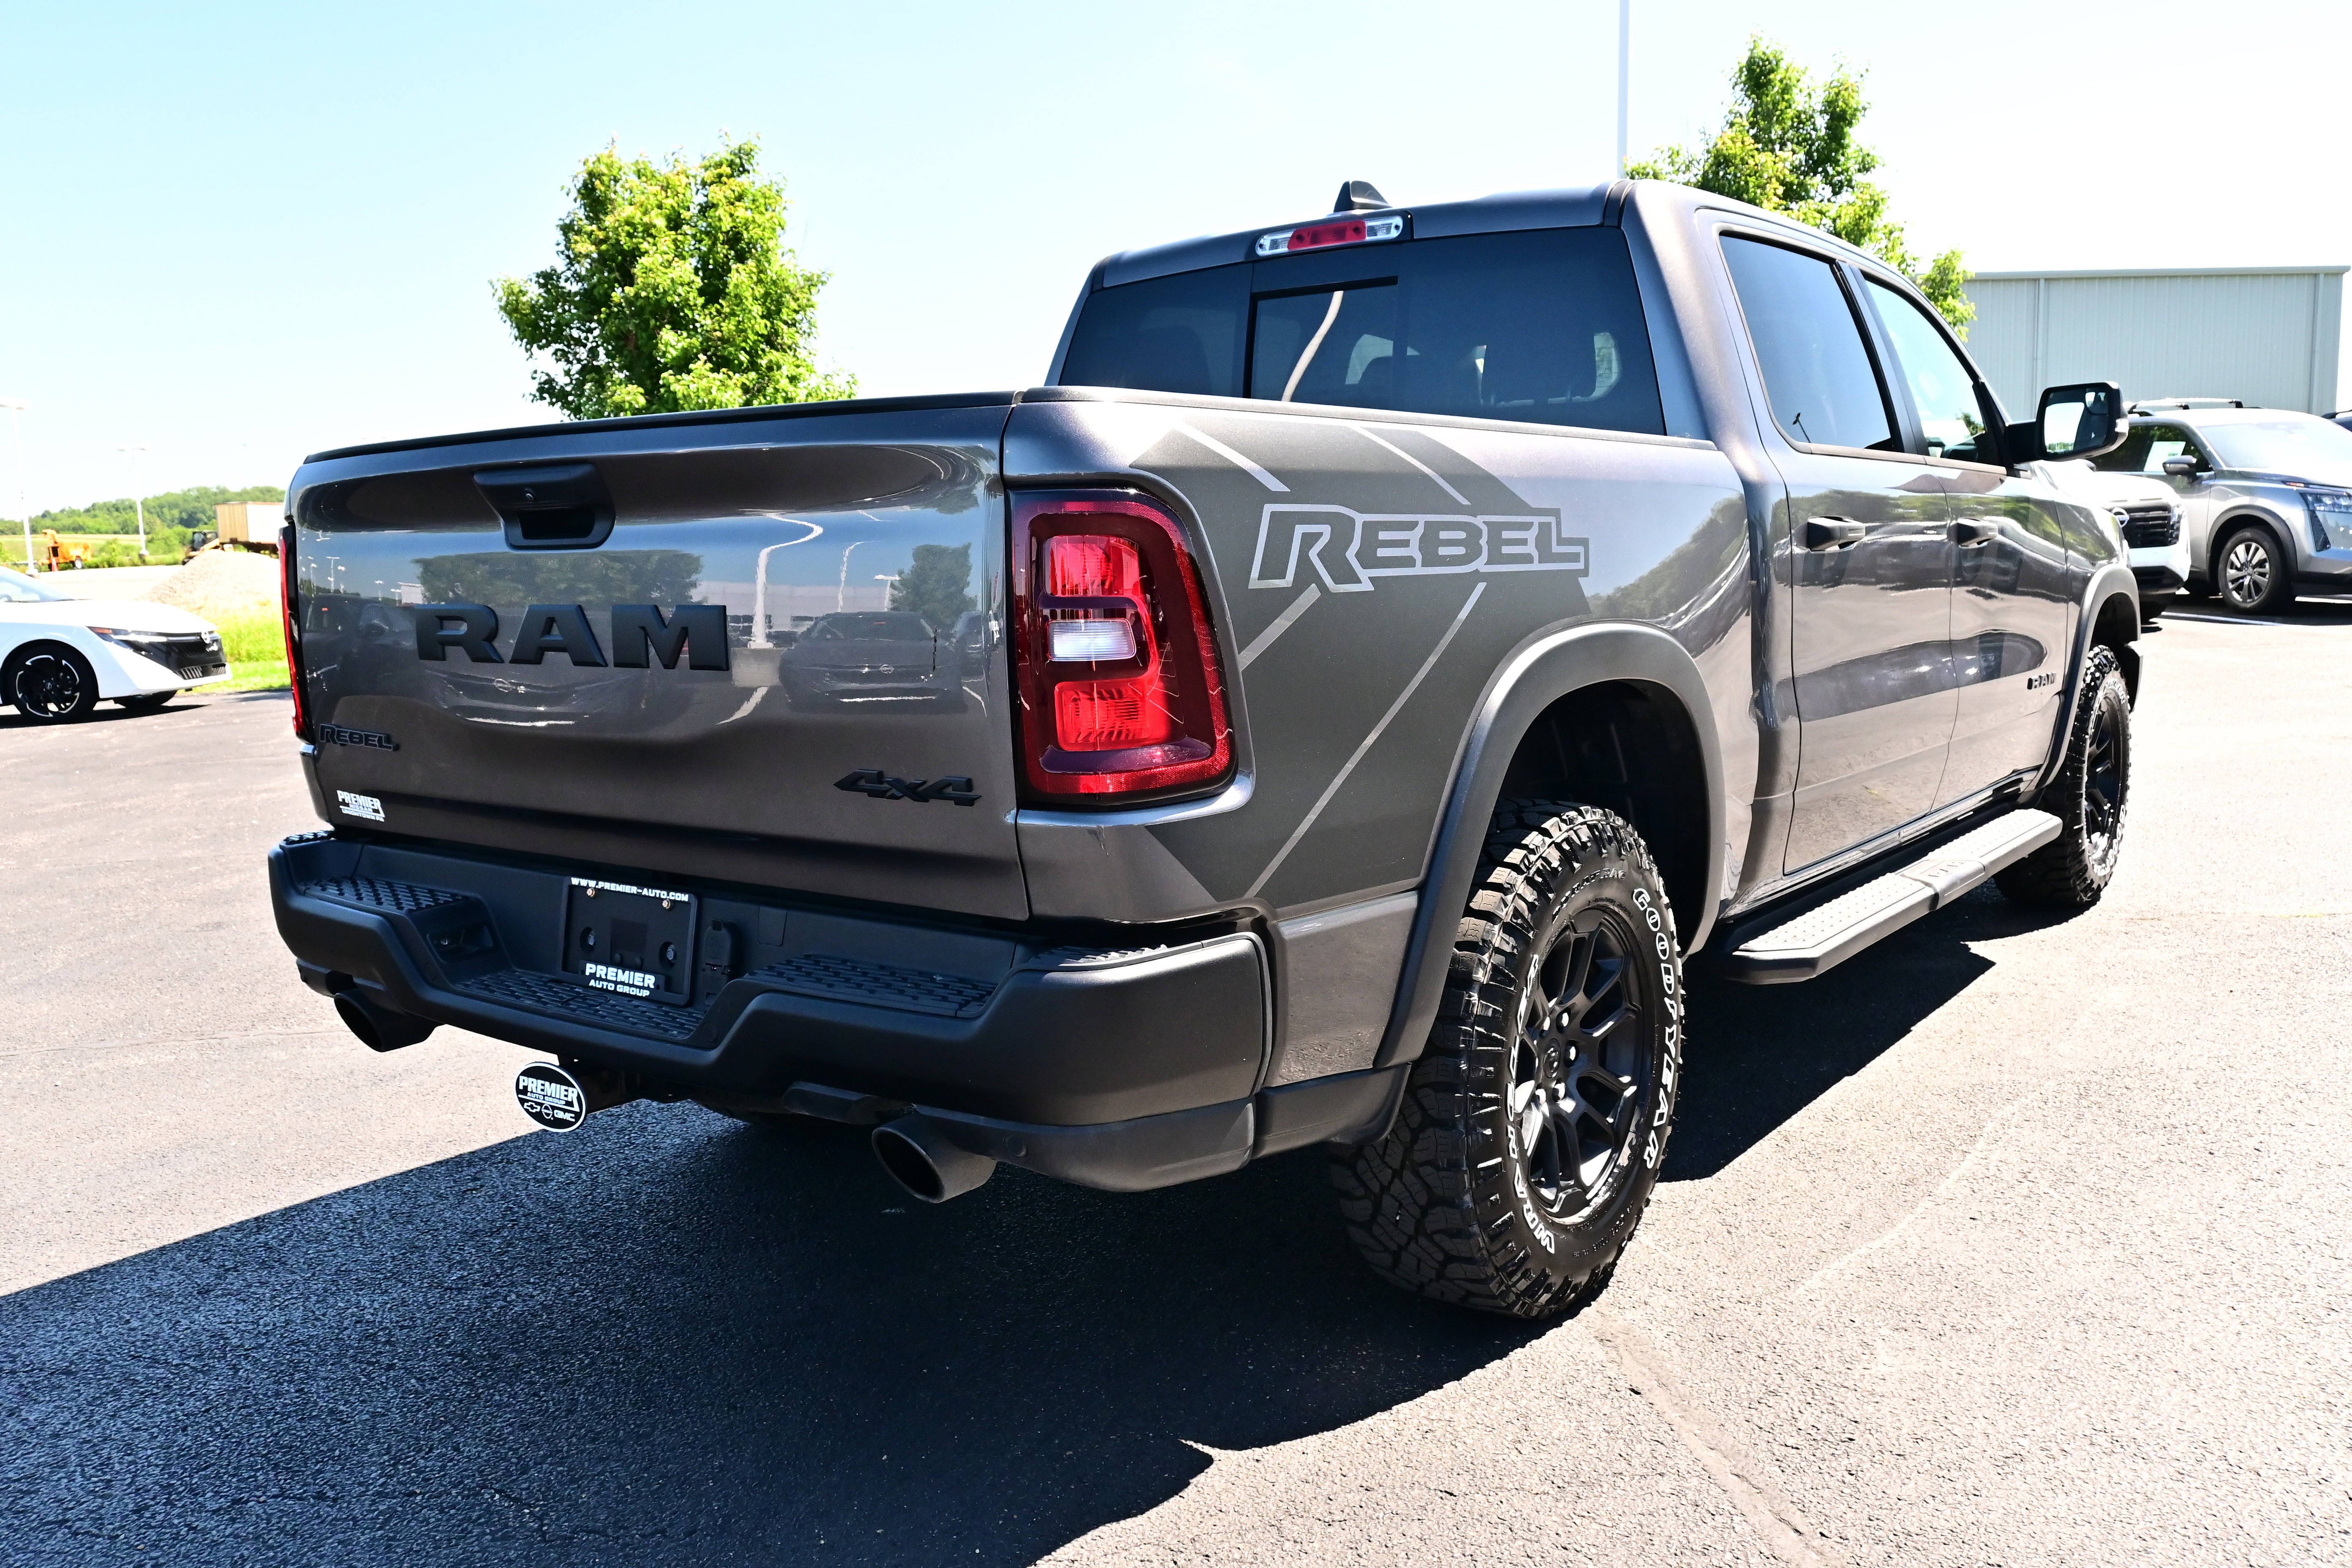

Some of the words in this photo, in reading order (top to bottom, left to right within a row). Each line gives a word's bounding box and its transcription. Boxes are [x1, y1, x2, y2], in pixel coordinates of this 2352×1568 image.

[1248, 504, 1584, 592] REBEL
[414, 604, 729, 671] RAM
[2028, 671, 2056, 690] RAM
[319, 723, 400, 751] REBEL
[337, 789, 380, 810] PREMIER
[349, 803, 373, 813] NISSAN
[571, 877, 689, 902] WWW.PREMIER-AUTO.COM
[585, 963, 656, 989] PREMIER
[589, 979, 615, 991] AUTO
[616, 984, 650, 997] GROUP
[1632, 888, 1678, 1169] GOODYEAR
[519, 1075, 578, 1102] PREMIER
[527, 1092, 544, 1100] AUTO
[544, 1096, 566, 1105] GROUP
[554, 1109, 575, 1122] GMC
[1507, 954, 1555, 1255] WRANGLER
